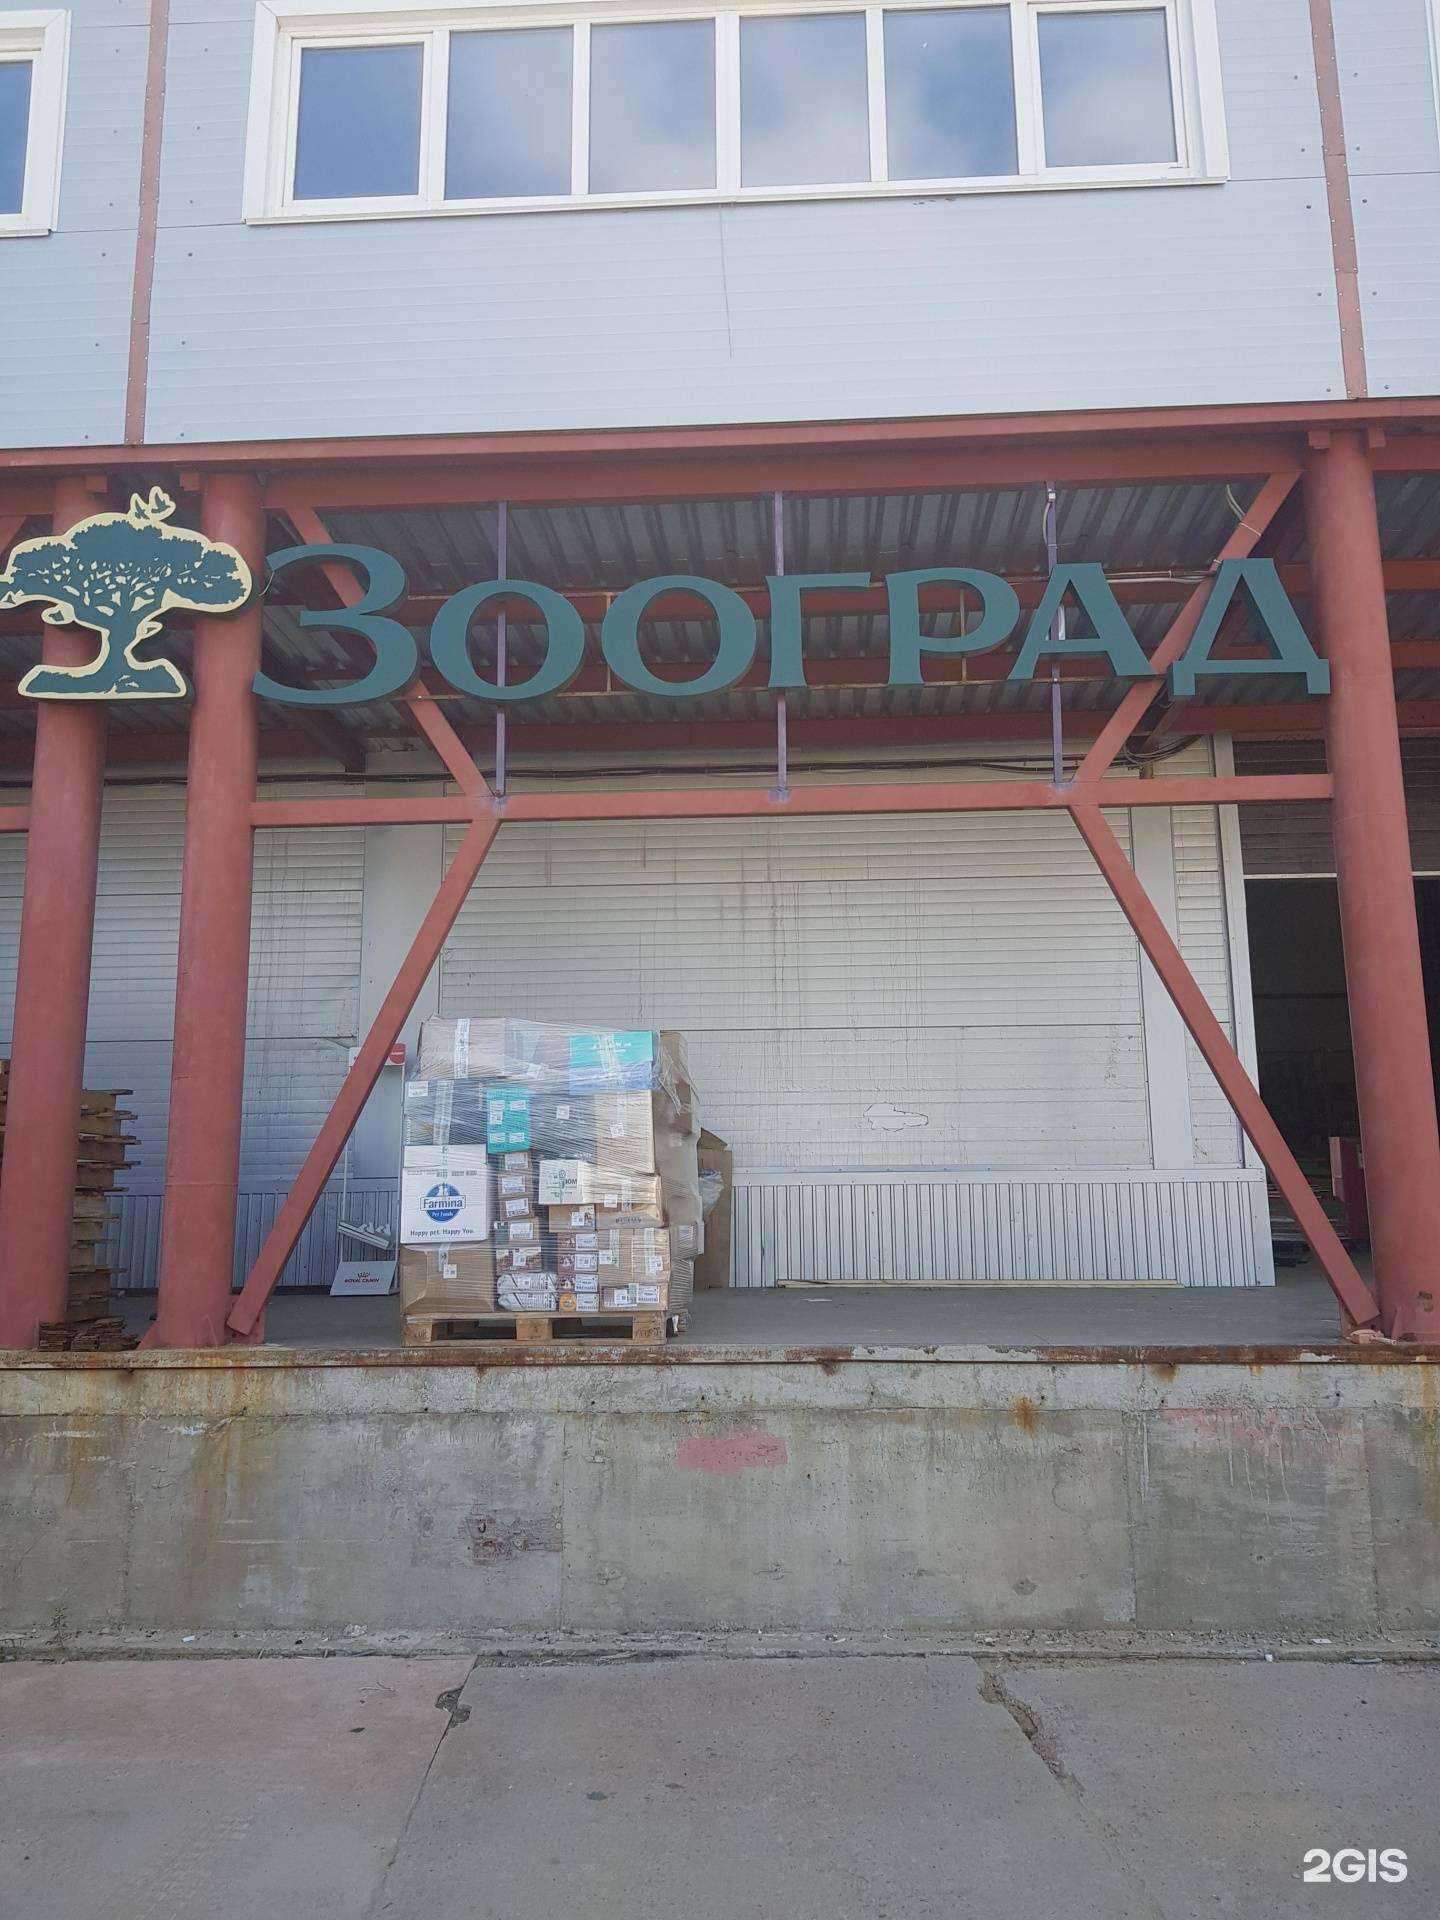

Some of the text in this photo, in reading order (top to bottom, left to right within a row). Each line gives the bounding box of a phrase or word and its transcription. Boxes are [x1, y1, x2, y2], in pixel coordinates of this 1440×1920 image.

[252, 543, 1331, 705] ЗООГРАД
[423, 1197, 463, 1209] Farmina
[410, 1229, 428, 1237] Happy
[442, 1228, 461, 1236] Happy
